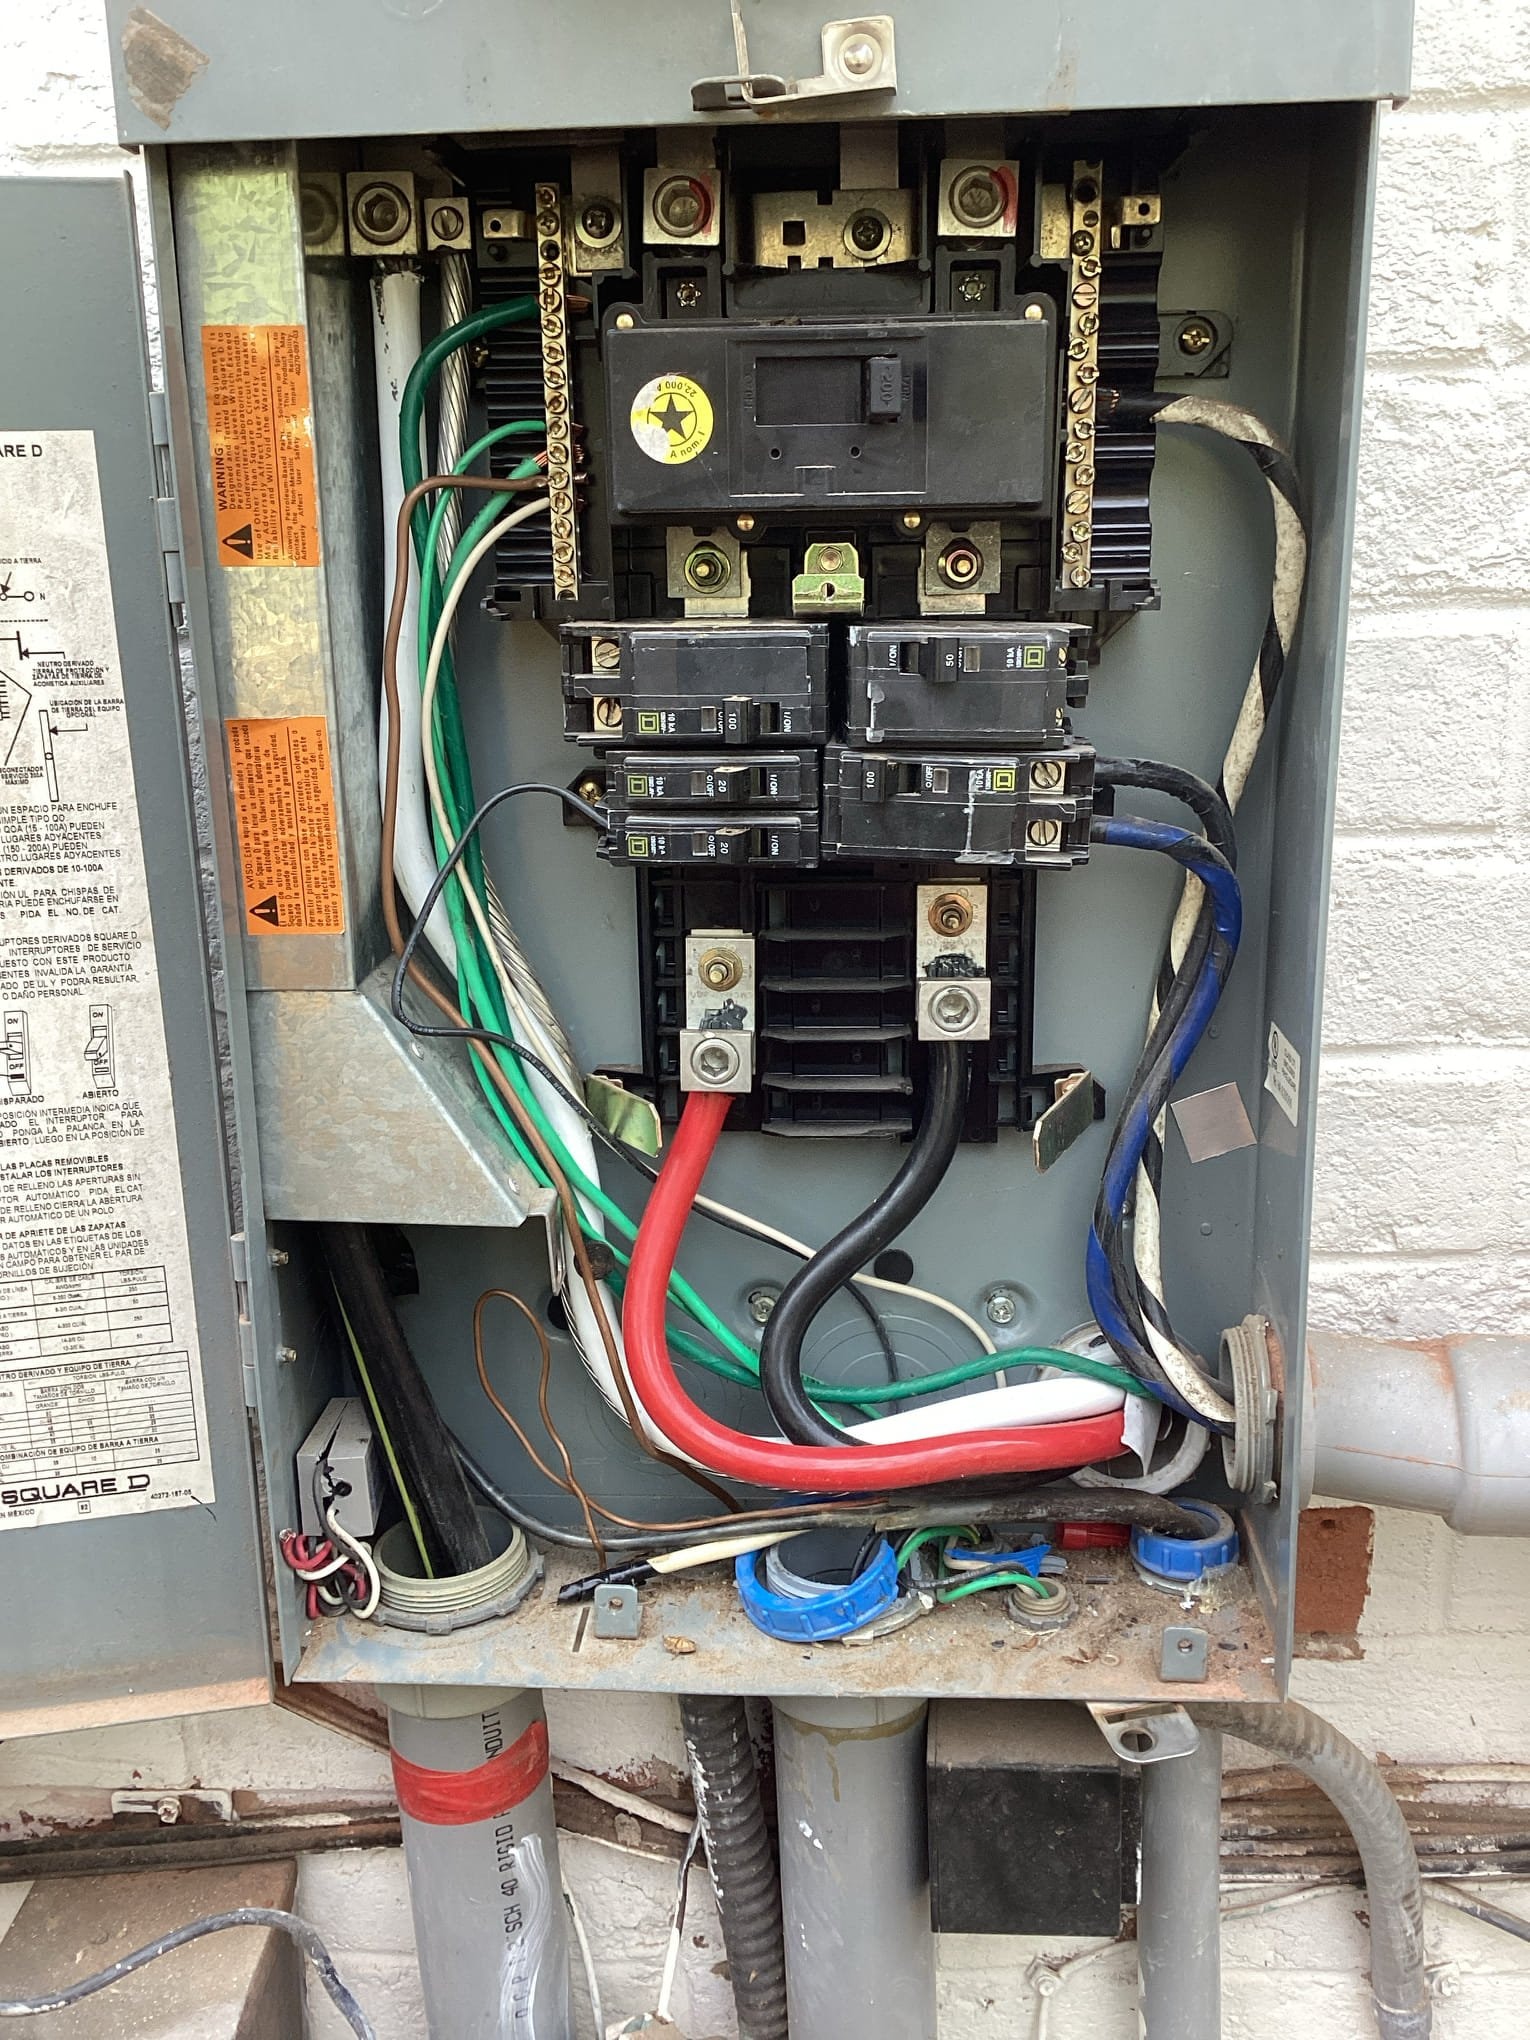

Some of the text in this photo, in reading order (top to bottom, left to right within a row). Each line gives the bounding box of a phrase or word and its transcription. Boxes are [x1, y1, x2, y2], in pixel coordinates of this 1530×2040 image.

[208, 332, 215, 340] is
[217, 332, 224, 342] to
[210, 346, 220, 406] Equipment
[219, 358, 227, 391] Square
[221, 395, 228, 406] by
[245, 381, 253, 414] Circuit
[224, 332, 244, 509] Performance Levels Which Exceed
[238, 386, 247, 445] Laboratories
[222, 409, 230, 440] Tested
[32, 444, 42, 457] D
[248, 430, 256, 464] Square
[256, 444, 264, 477] Affect
[214, 443, 227, 511] WARNING:
[242, 449, 251, 510] Underwriters
[226, 466, 236, 509] Designed
[267, 487, 275, 504] and
[260, 483, 269, 534] Adversely
[253, 528, 262, 539] of
[946, 653, 954, 667] 50
[728, 712, 737, 730] 100
[718, 780, 726, 792] 20
[866, 771, 876, 789] 100
[11, 802, 117, 814] ESPACIO PARA ENCHUFE
[2, 832, 102, 843] LUGARES ADYACENTES
[21, 850, 120, 862] LUGARES ADYACENTES
[720, 842, 728, 854] 20
[4, 864, 104, 876] DERIVADOS DE 10-100A
[34, 886, 114, 898] PARA CHISPAS DE
[42, 931, 137, 944] DERIVADOS SQUARE D
[9, 942, 142, 956] INTERRUPTORES DE SERVICIO
[32, 953, 130, 966] CON ESTE PRODUCTO
[34, 968, 72, 977] INVALIDA
[75, 966, 86, 974] LA
[82, 1090, 119, 1099] ABIERTO
[40, 1102, 140, 1116] INTERMEDIA INDICA QUE
[19, 1154, 109, 1170] PLACAS REMOVIBLES
[35, 1162, 124, 1178] LOS INTERRUPTORES
[19, 1222, 126, 1238] APRIETE ZAPATAS
[2, 1474, 150, 1504] SQUARE D
[494, 1823, 514, 1872] RIGID
[501, 1877, 518, 1897] 40
[504, 1903, 523, 1934] SCH
